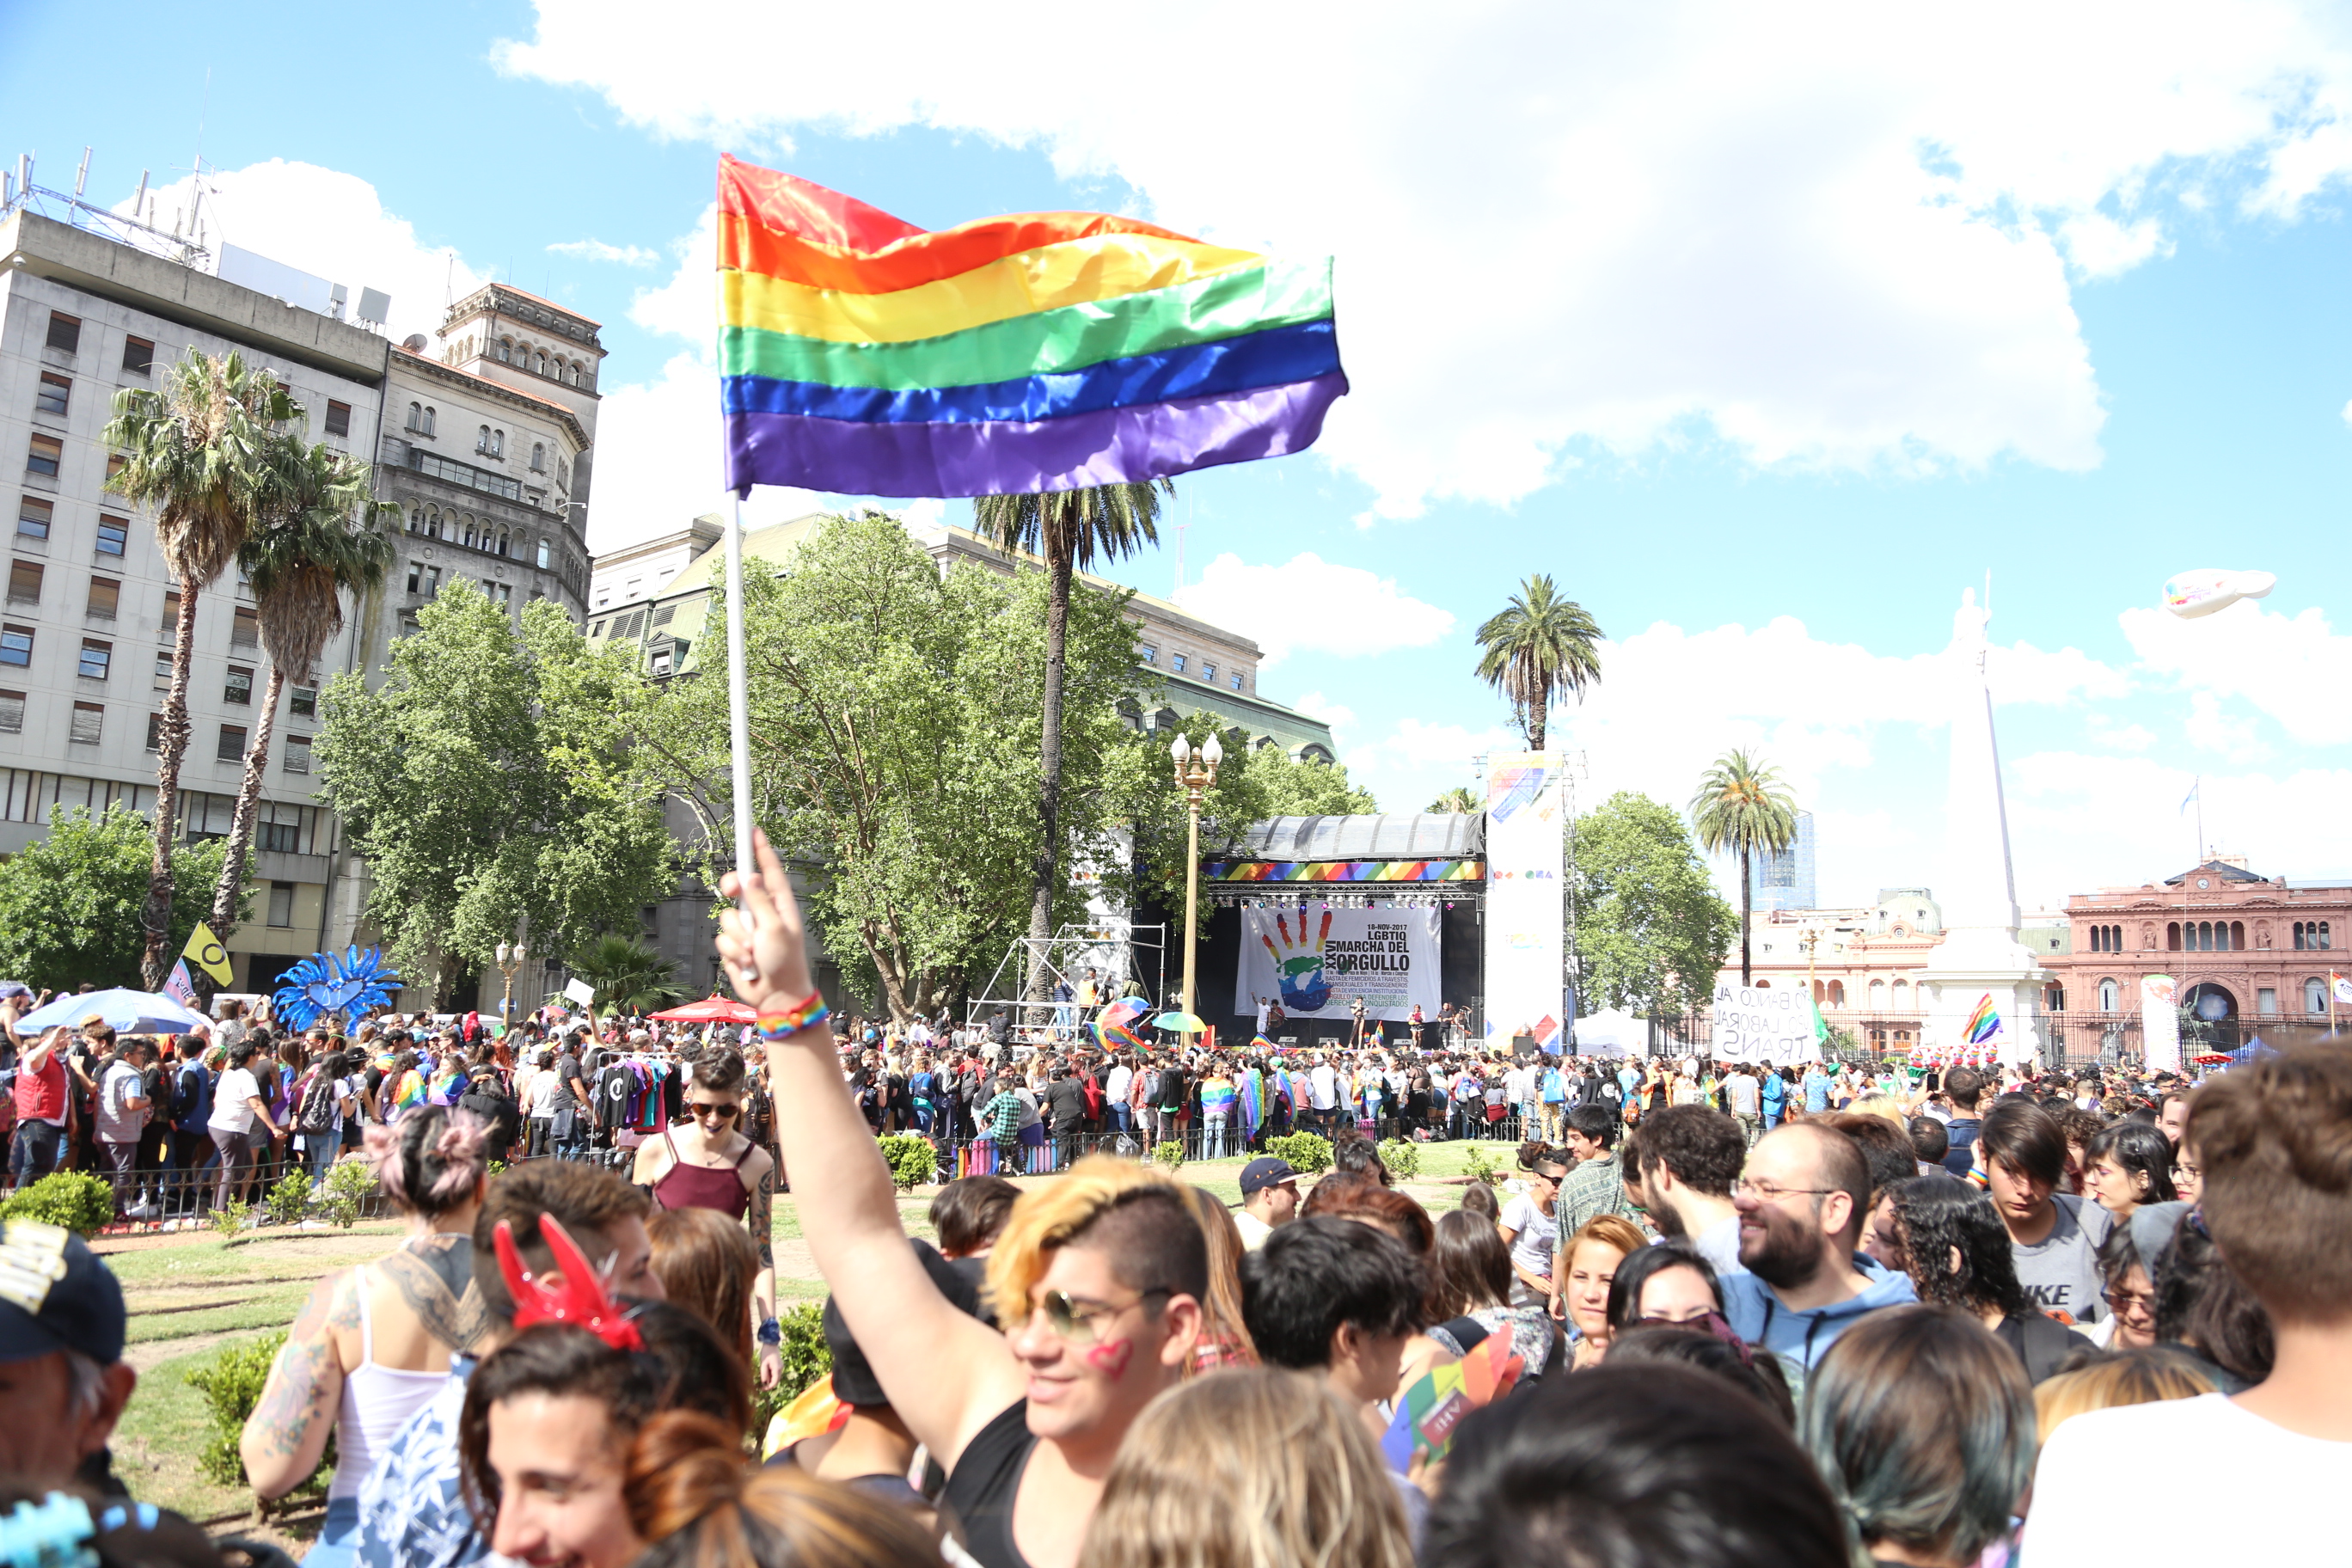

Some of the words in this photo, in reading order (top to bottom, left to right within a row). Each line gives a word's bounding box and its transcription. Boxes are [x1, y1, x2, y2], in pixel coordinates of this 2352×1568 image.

[1367, 931, 1407, 942] LGBTIQ
[1325, 940, 1336, 971] XXVI
[1336, 940, 1385, 952] MARCHA
[1388, 941, 1410, 953] DEL
[1336, 953, 1410, 971] ORGULLO
[2023, 1284, 2072, 1306] IKE
